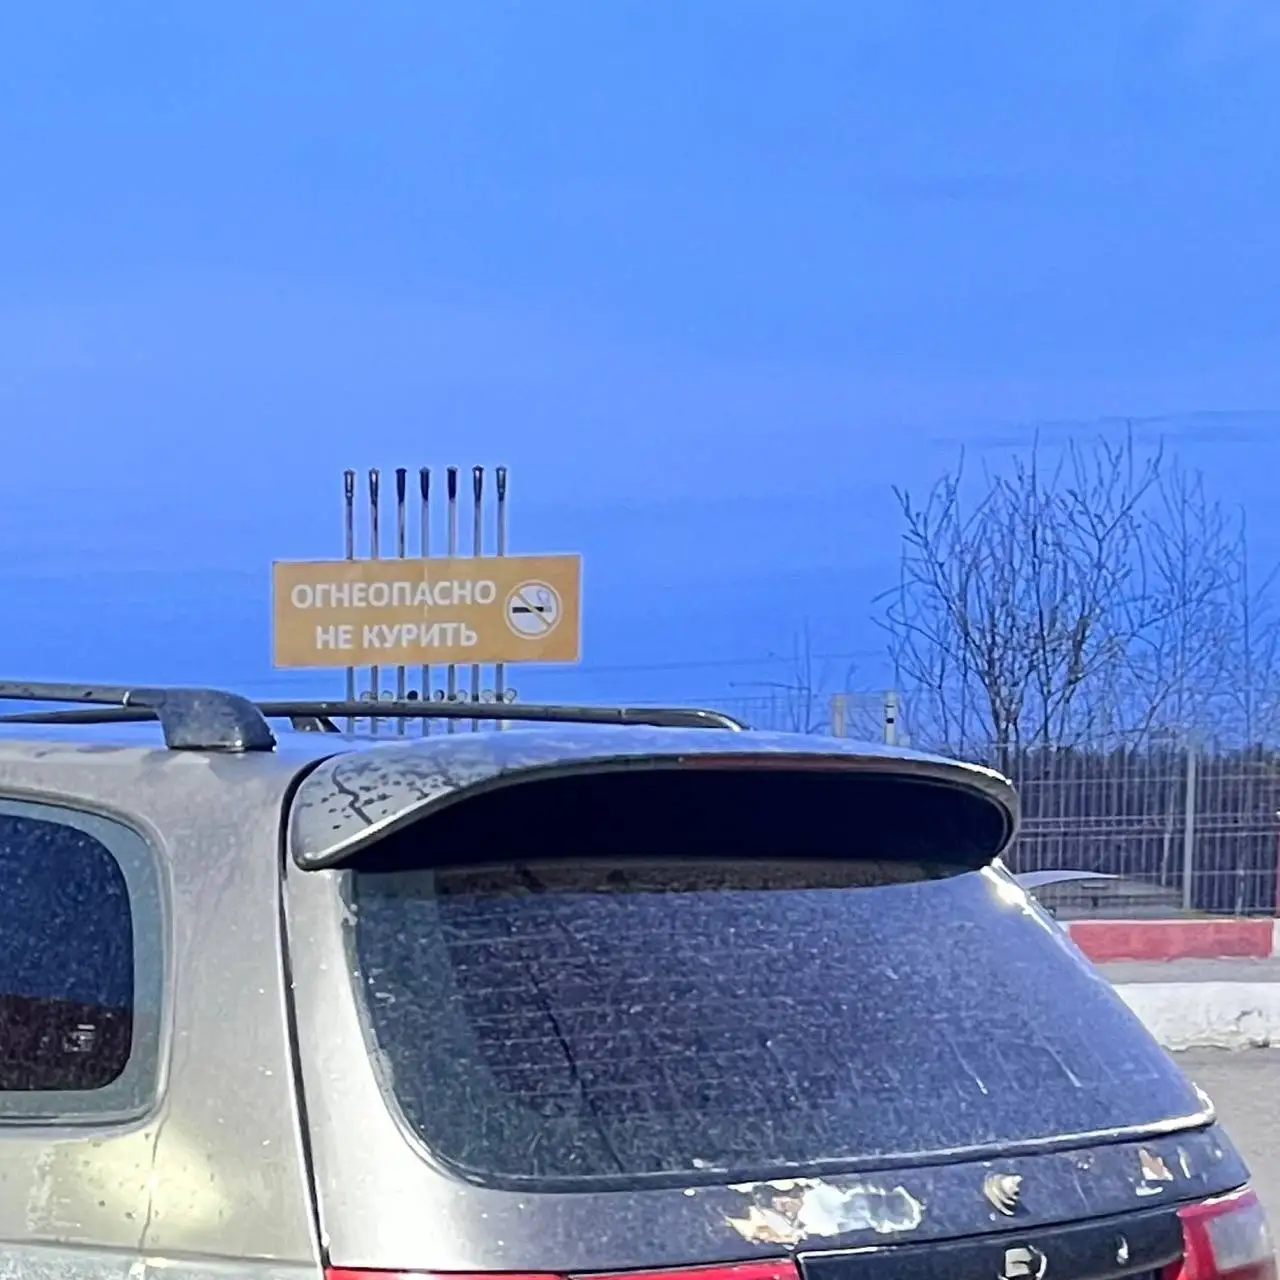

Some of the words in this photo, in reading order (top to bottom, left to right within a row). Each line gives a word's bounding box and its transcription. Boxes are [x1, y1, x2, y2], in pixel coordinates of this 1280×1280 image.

[291, 580, 497, 610] ОГНЕОПАСНО
[316, 625, 354, 650] НЕ
[363, 622, 478, 649] КУРИТЬ
